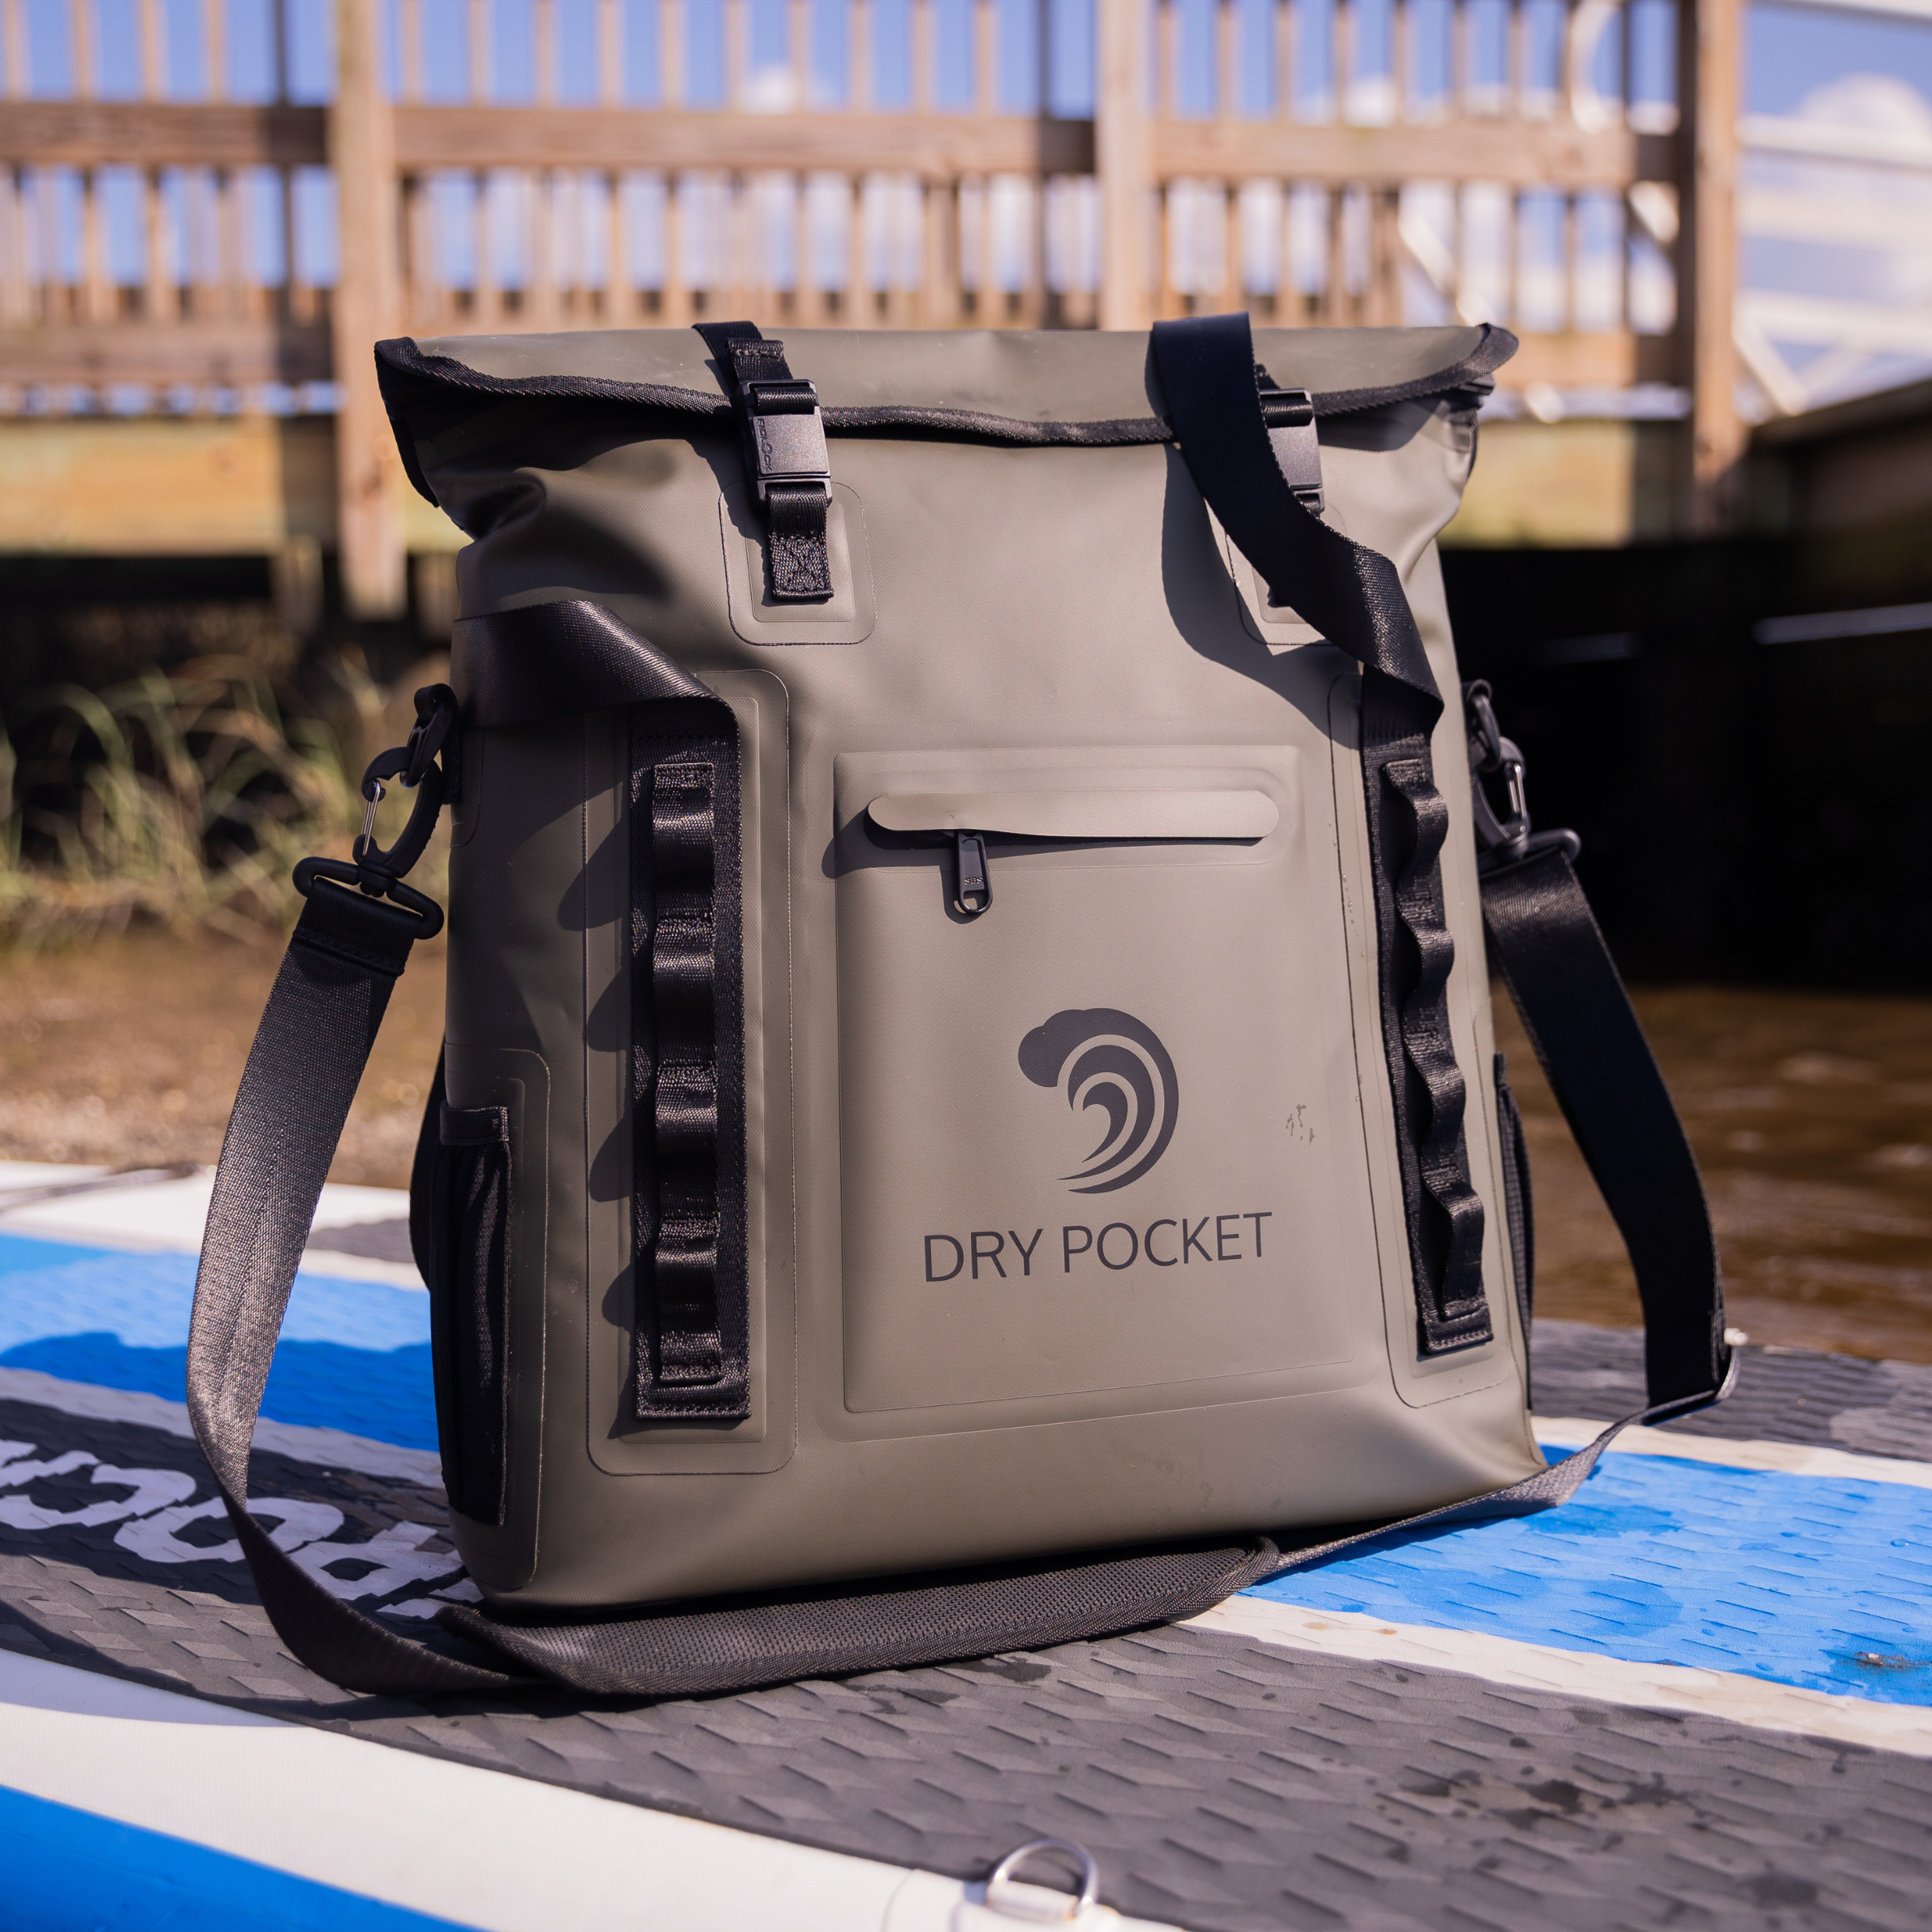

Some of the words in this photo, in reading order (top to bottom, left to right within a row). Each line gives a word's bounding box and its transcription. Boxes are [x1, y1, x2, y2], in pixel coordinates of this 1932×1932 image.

[758, 418, 773, 472] FIDLOCK
[924, 1228, 1044, 1283] DRY
[1063, 1211, 1273, 1274] POCKET
